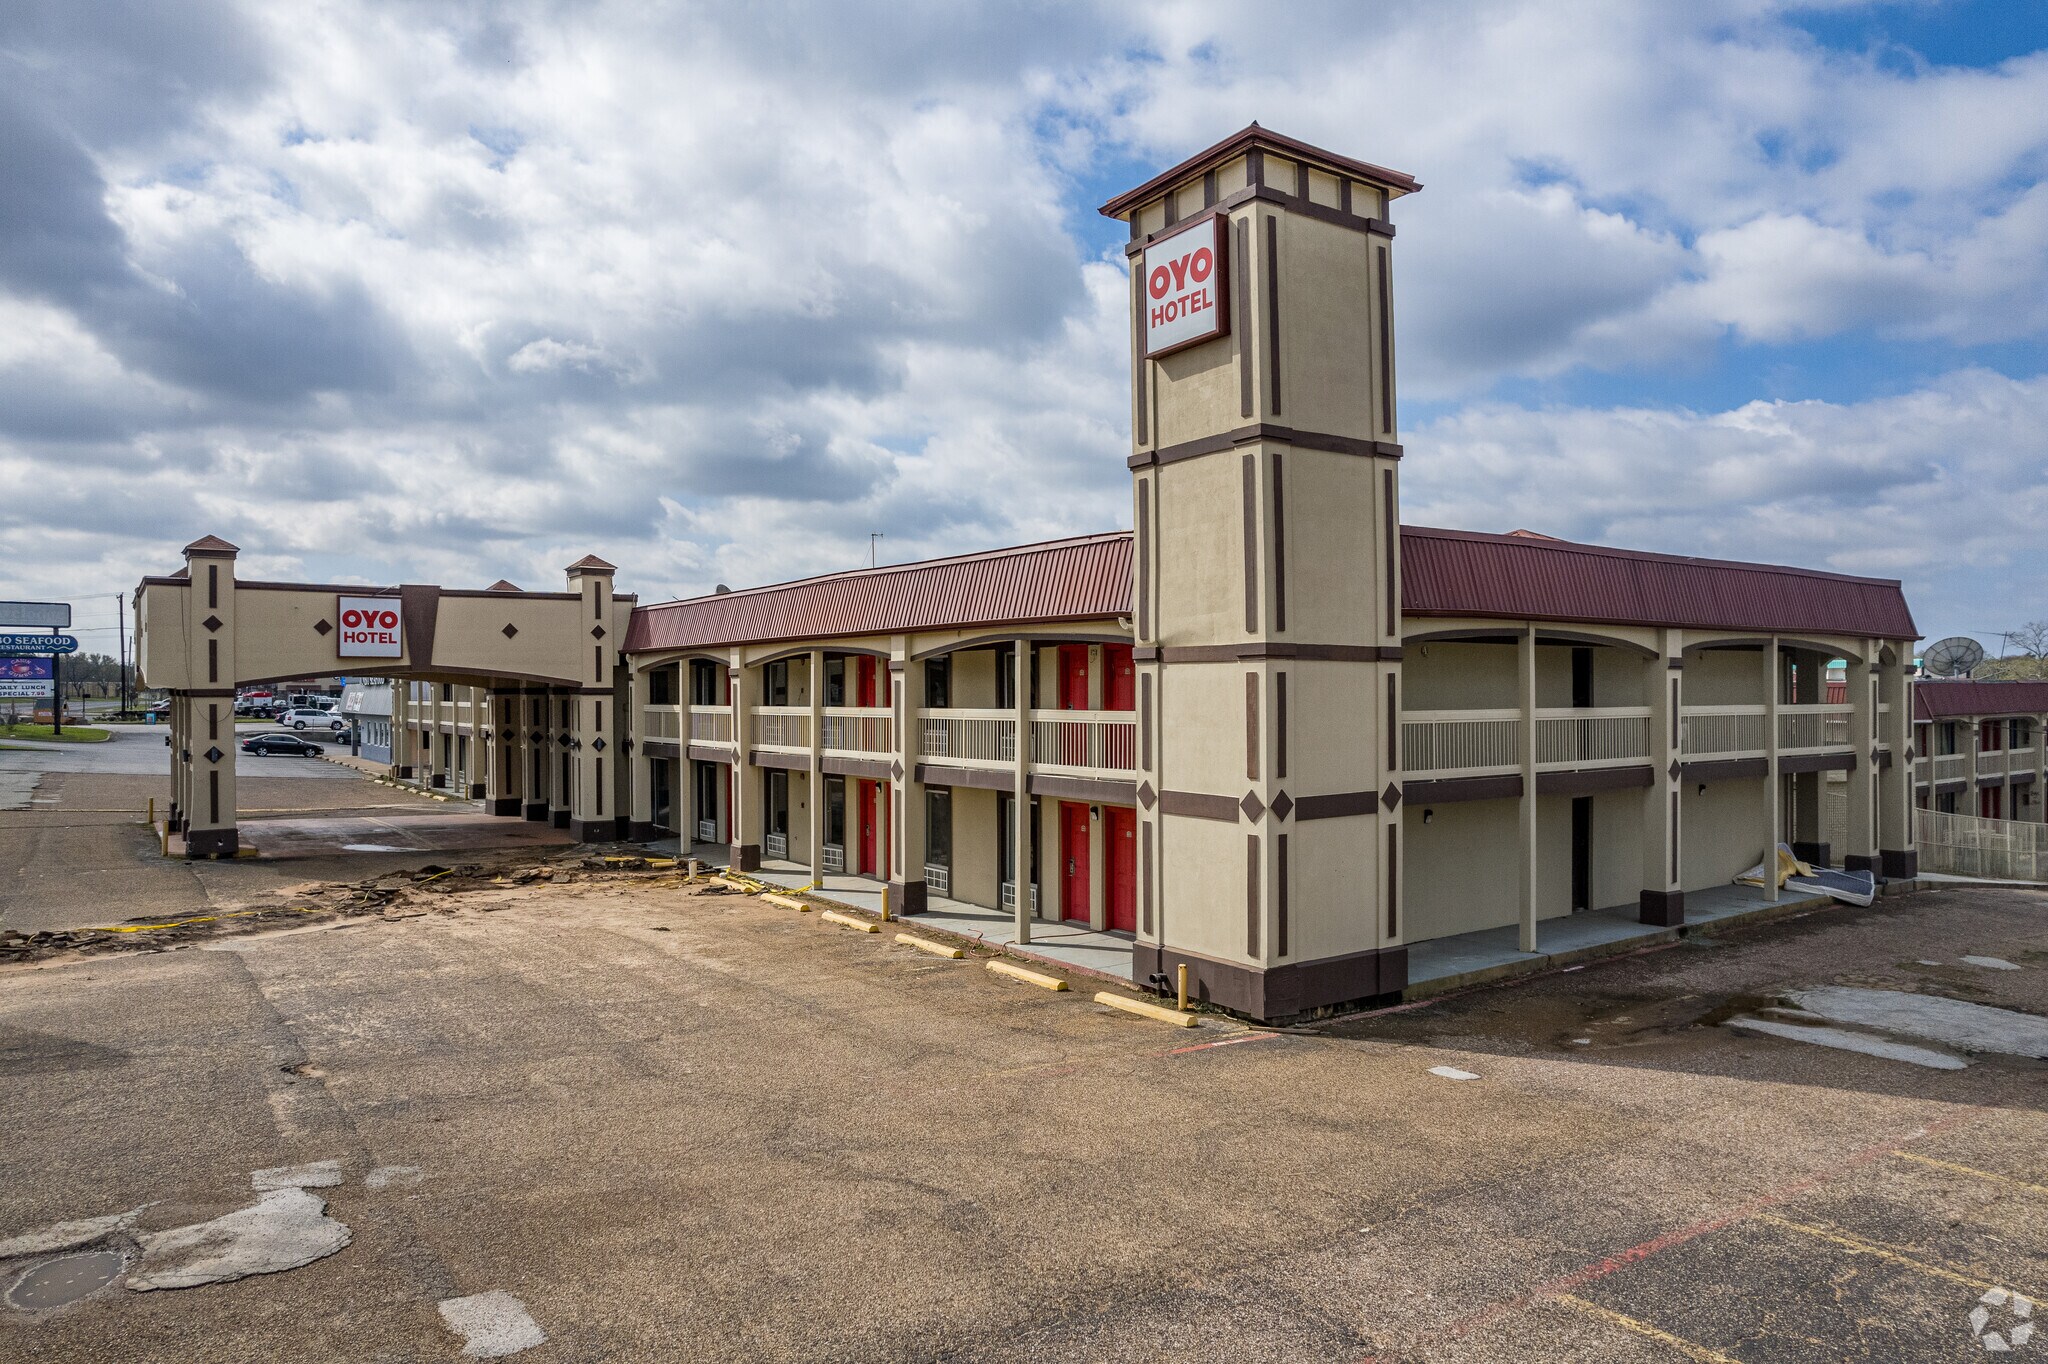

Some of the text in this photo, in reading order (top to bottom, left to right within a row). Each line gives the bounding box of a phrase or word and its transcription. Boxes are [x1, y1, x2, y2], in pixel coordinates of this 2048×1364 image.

[1149, 247, 1213, 300] OYO
[1151, 288, 1213, 329] HOTEL
[342, 609, 398, 629] OYO
[15, 637, 71, 645] SEAFOOD
[344, 631, 398, 644] HOTEL
